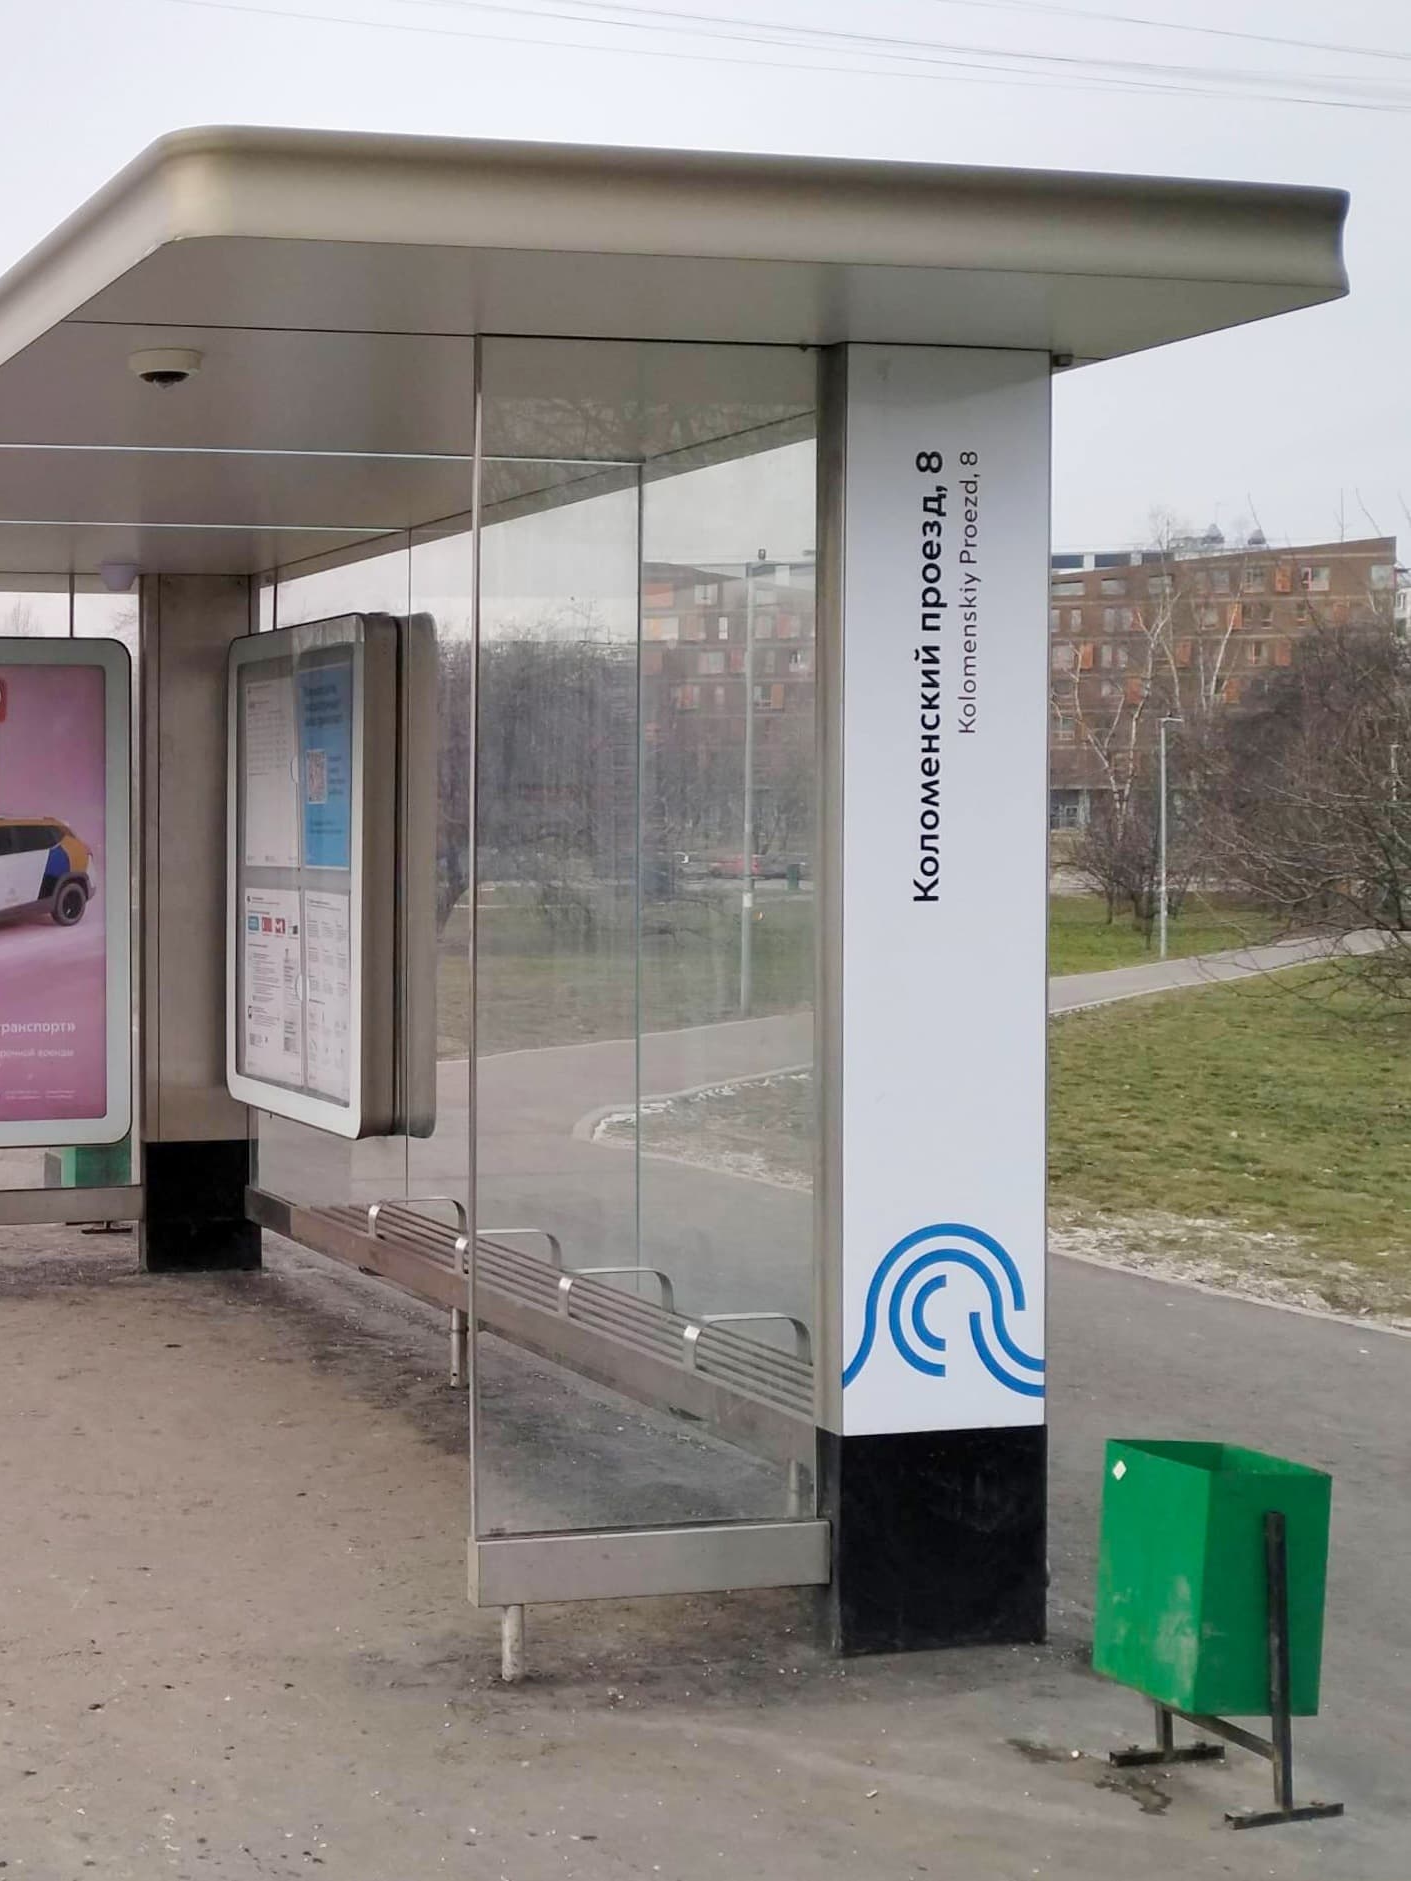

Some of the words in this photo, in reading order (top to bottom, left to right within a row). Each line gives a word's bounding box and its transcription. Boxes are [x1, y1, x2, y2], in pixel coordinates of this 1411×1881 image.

[915, 451, 943, 474] 8
[959, 451, 979, 466] 8
[921, 485, 948, 632] проезд,
[959, 473, 981, 564] Proezd,
[958, 572, 981, 734] Kolomenskiy
[913, 644, 941, 902] Коломенский
